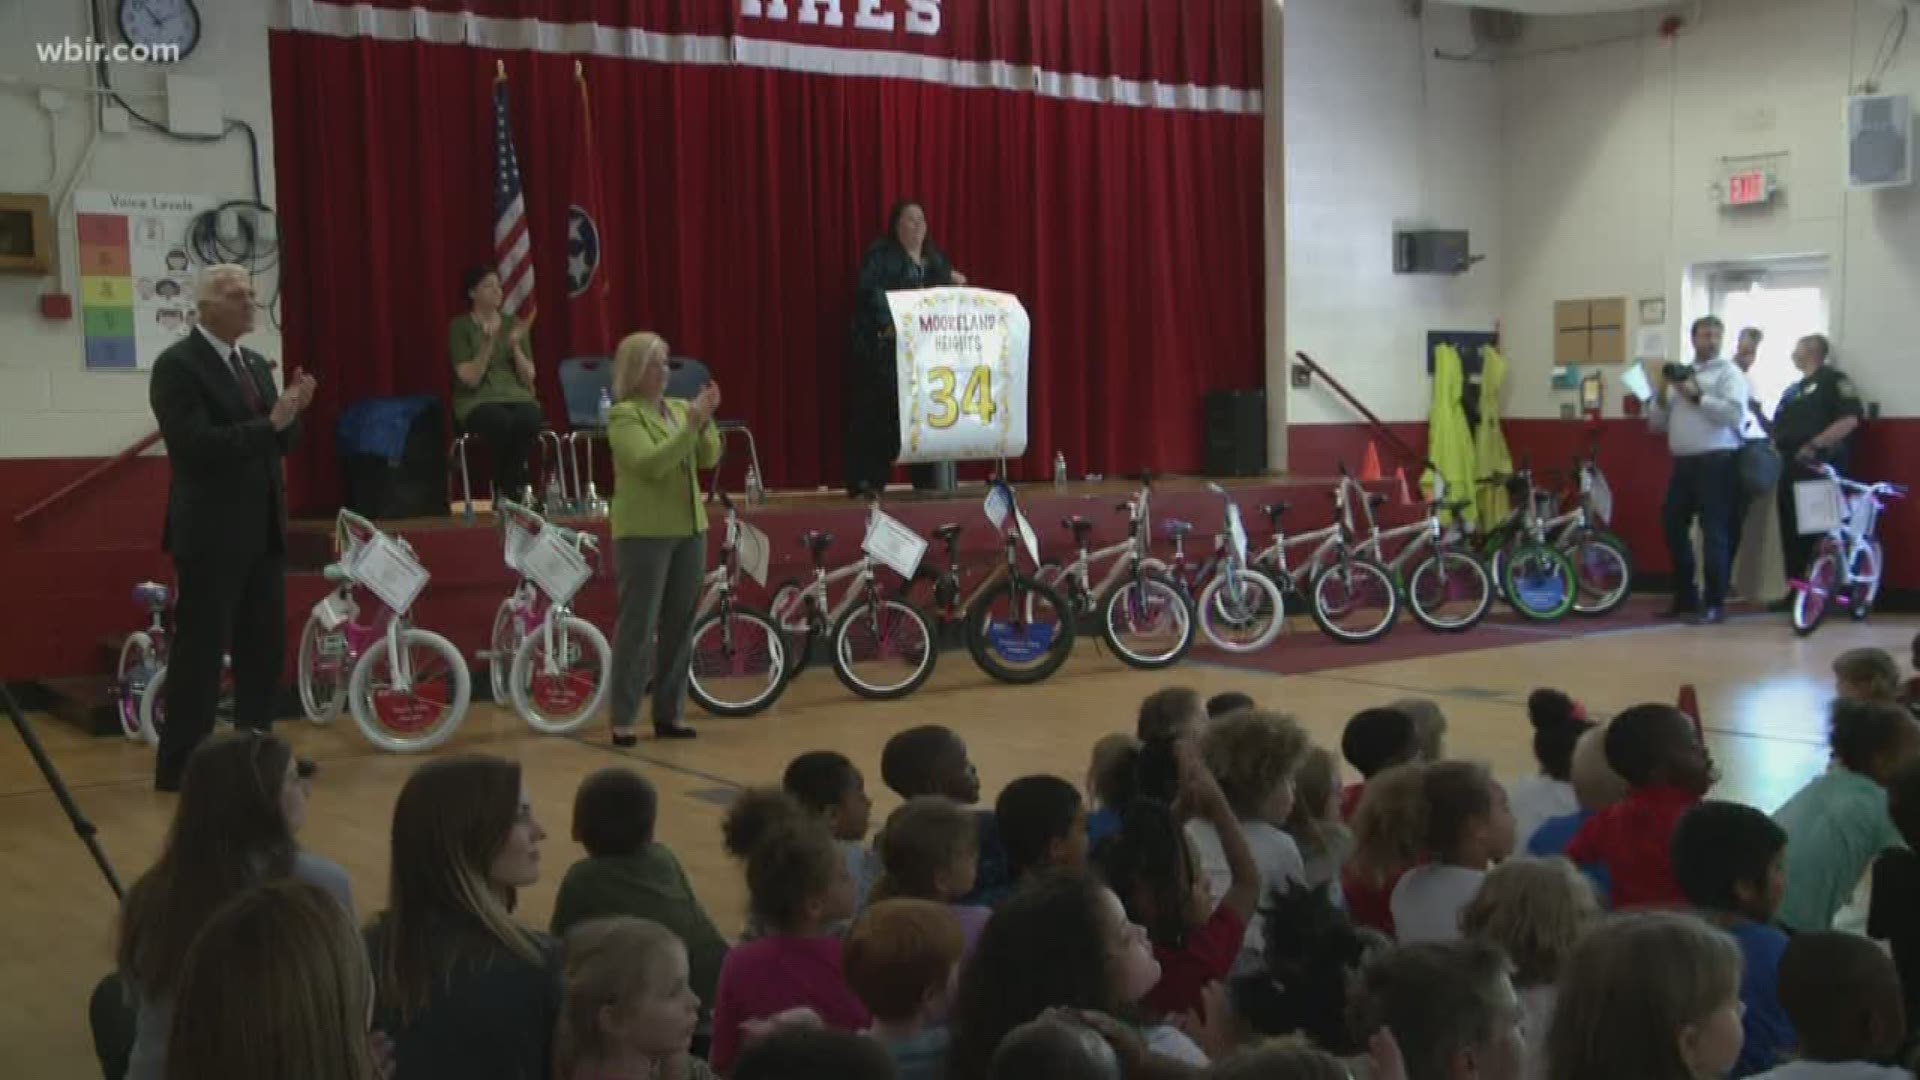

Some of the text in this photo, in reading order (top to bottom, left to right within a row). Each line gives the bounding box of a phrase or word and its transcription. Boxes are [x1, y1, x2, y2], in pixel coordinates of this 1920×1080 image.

[1729, 171, 1763, 205] EXIT
[109, 193, 193, 211] Voice Levels
[919, 314, 996, 332] MOORELAND
[935, 336, 982, 352] HEIGHTS
[926, 365, 997, 429] 34
